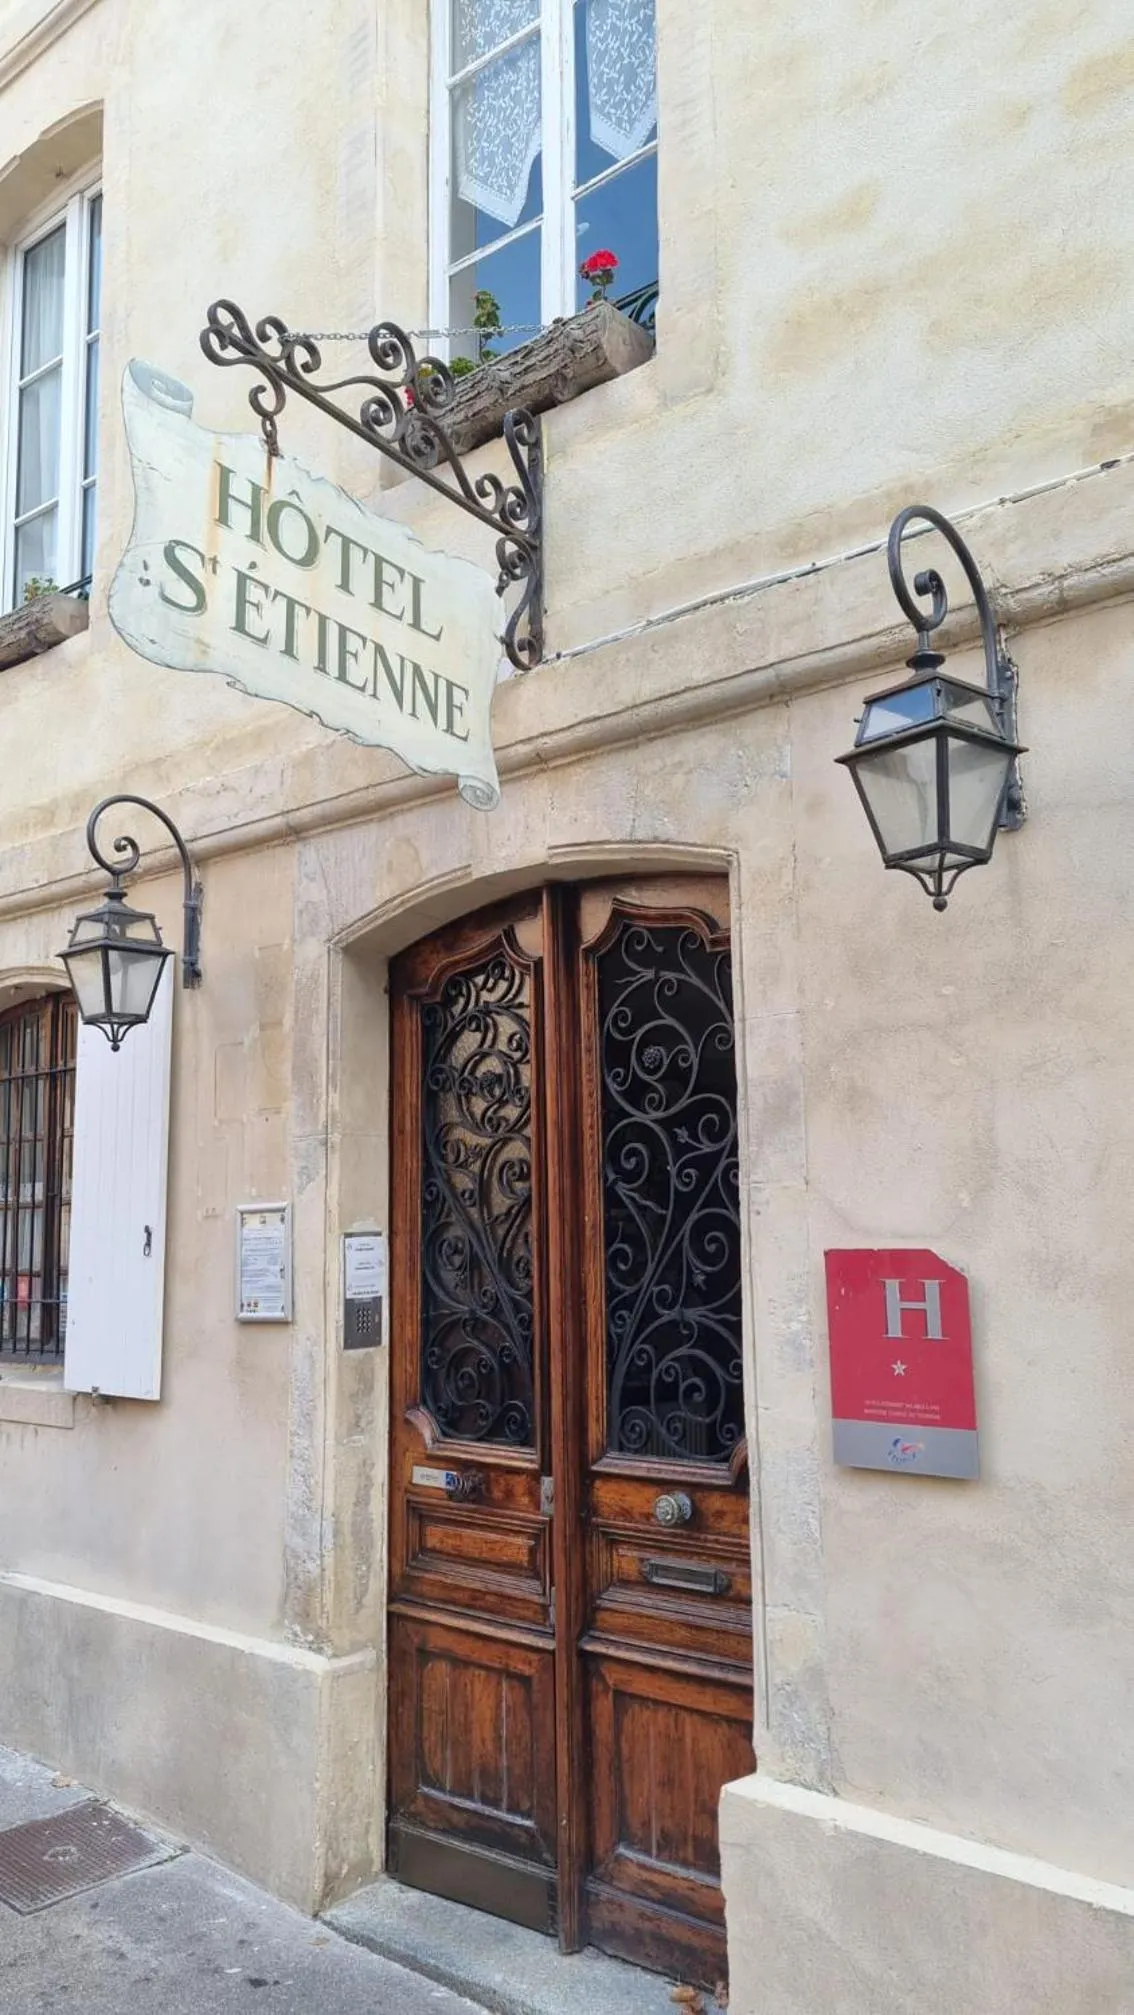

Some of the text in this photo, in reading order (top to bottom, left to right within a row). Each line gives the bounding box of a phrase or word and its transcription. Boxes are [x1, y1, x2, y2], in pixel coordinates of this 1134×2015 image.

[214, 461, 443, 642] HÔTEL
[229, 560, 471, 742] ÉTIENNE
[879, 1278, 950, 1340] H
